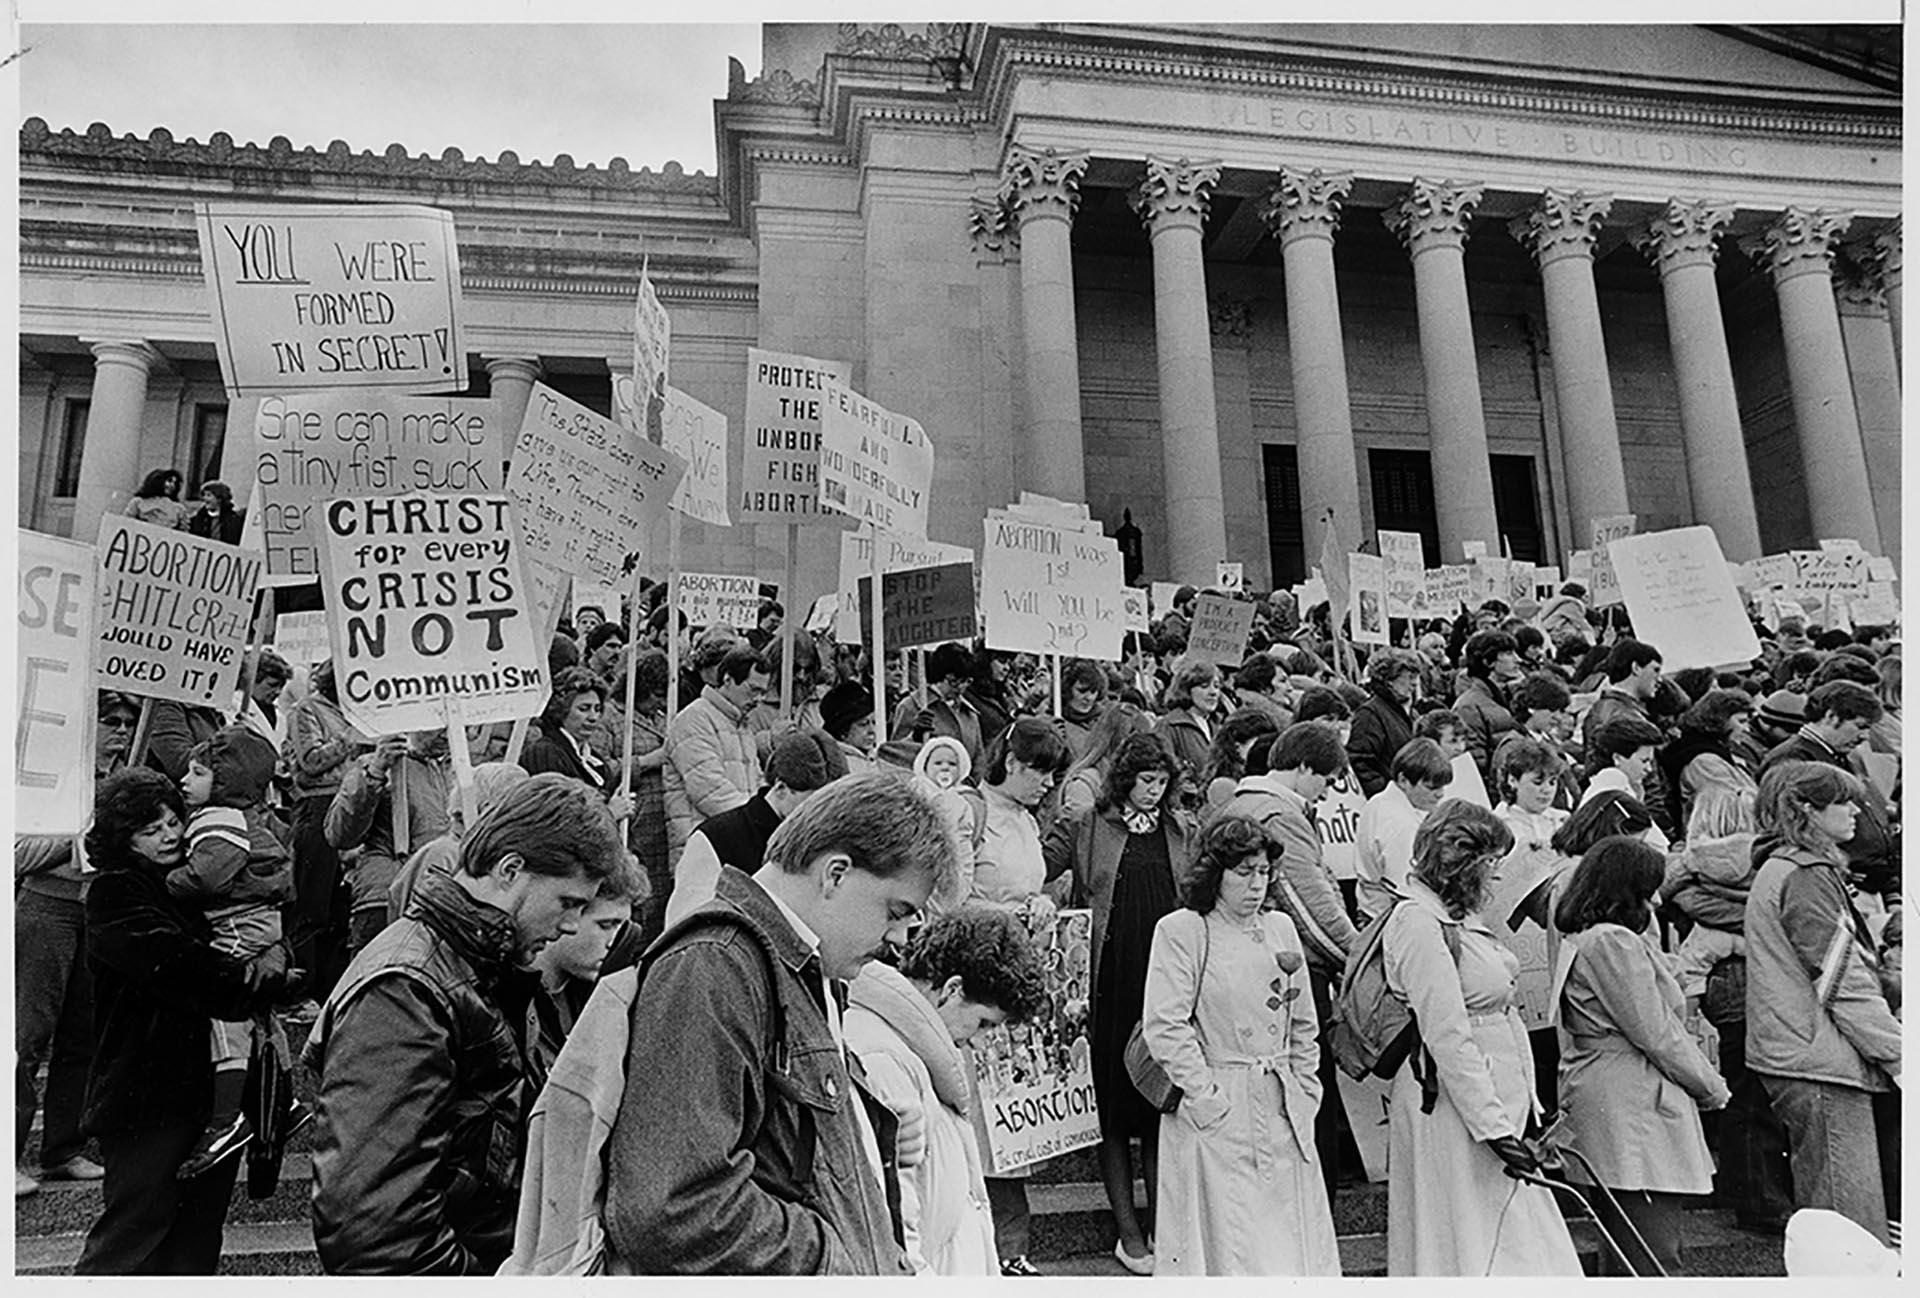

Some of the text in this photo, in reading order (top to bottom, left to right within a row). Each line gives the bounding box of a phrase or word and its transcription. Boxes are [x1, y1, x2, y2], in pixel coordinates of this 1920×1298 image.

[1244, 104, 1747, 168] LEGISLATIVE BUILDING
[224, 224, 436, 282] YOU WERE
[295, 290, 395, 326] FORMED
[272, 328, 452, 374] IN SECRET!
[260, 396, 485, 446] She can make
[779, 398, 819, 421] THE
[257, 452, 280, 485] a
[282, 441, 341, 494] tiny
[413, 448, 489, 491] suck
[860, 435, 889, 465] AND
[327, 497, 510, 537] CHRIST
[852, 496, 893, 528] ADE
[105, 528, 262, 604] ABORTION!
[354, 538, 511, 569] for every
[995, 524, 1109, 567] ABORTION was
[341, 566, 515, 612] CRISIS
[679, 575, 755, 595] ABORTION
[886, 571, 942, 596] STOP
[1046, 560, 1070, 585] 1st
[112, 579, 223, 640] HITLER
[892, 596, 934, 619] THE
[1003, 589, 1040, 616] Will
[183, 638, 234, 666] HAVE
[347, 608, 519, 659] NOT
[98, 656, 219, 699] OVED IT!
[345, 661, 542, 704] Communism
